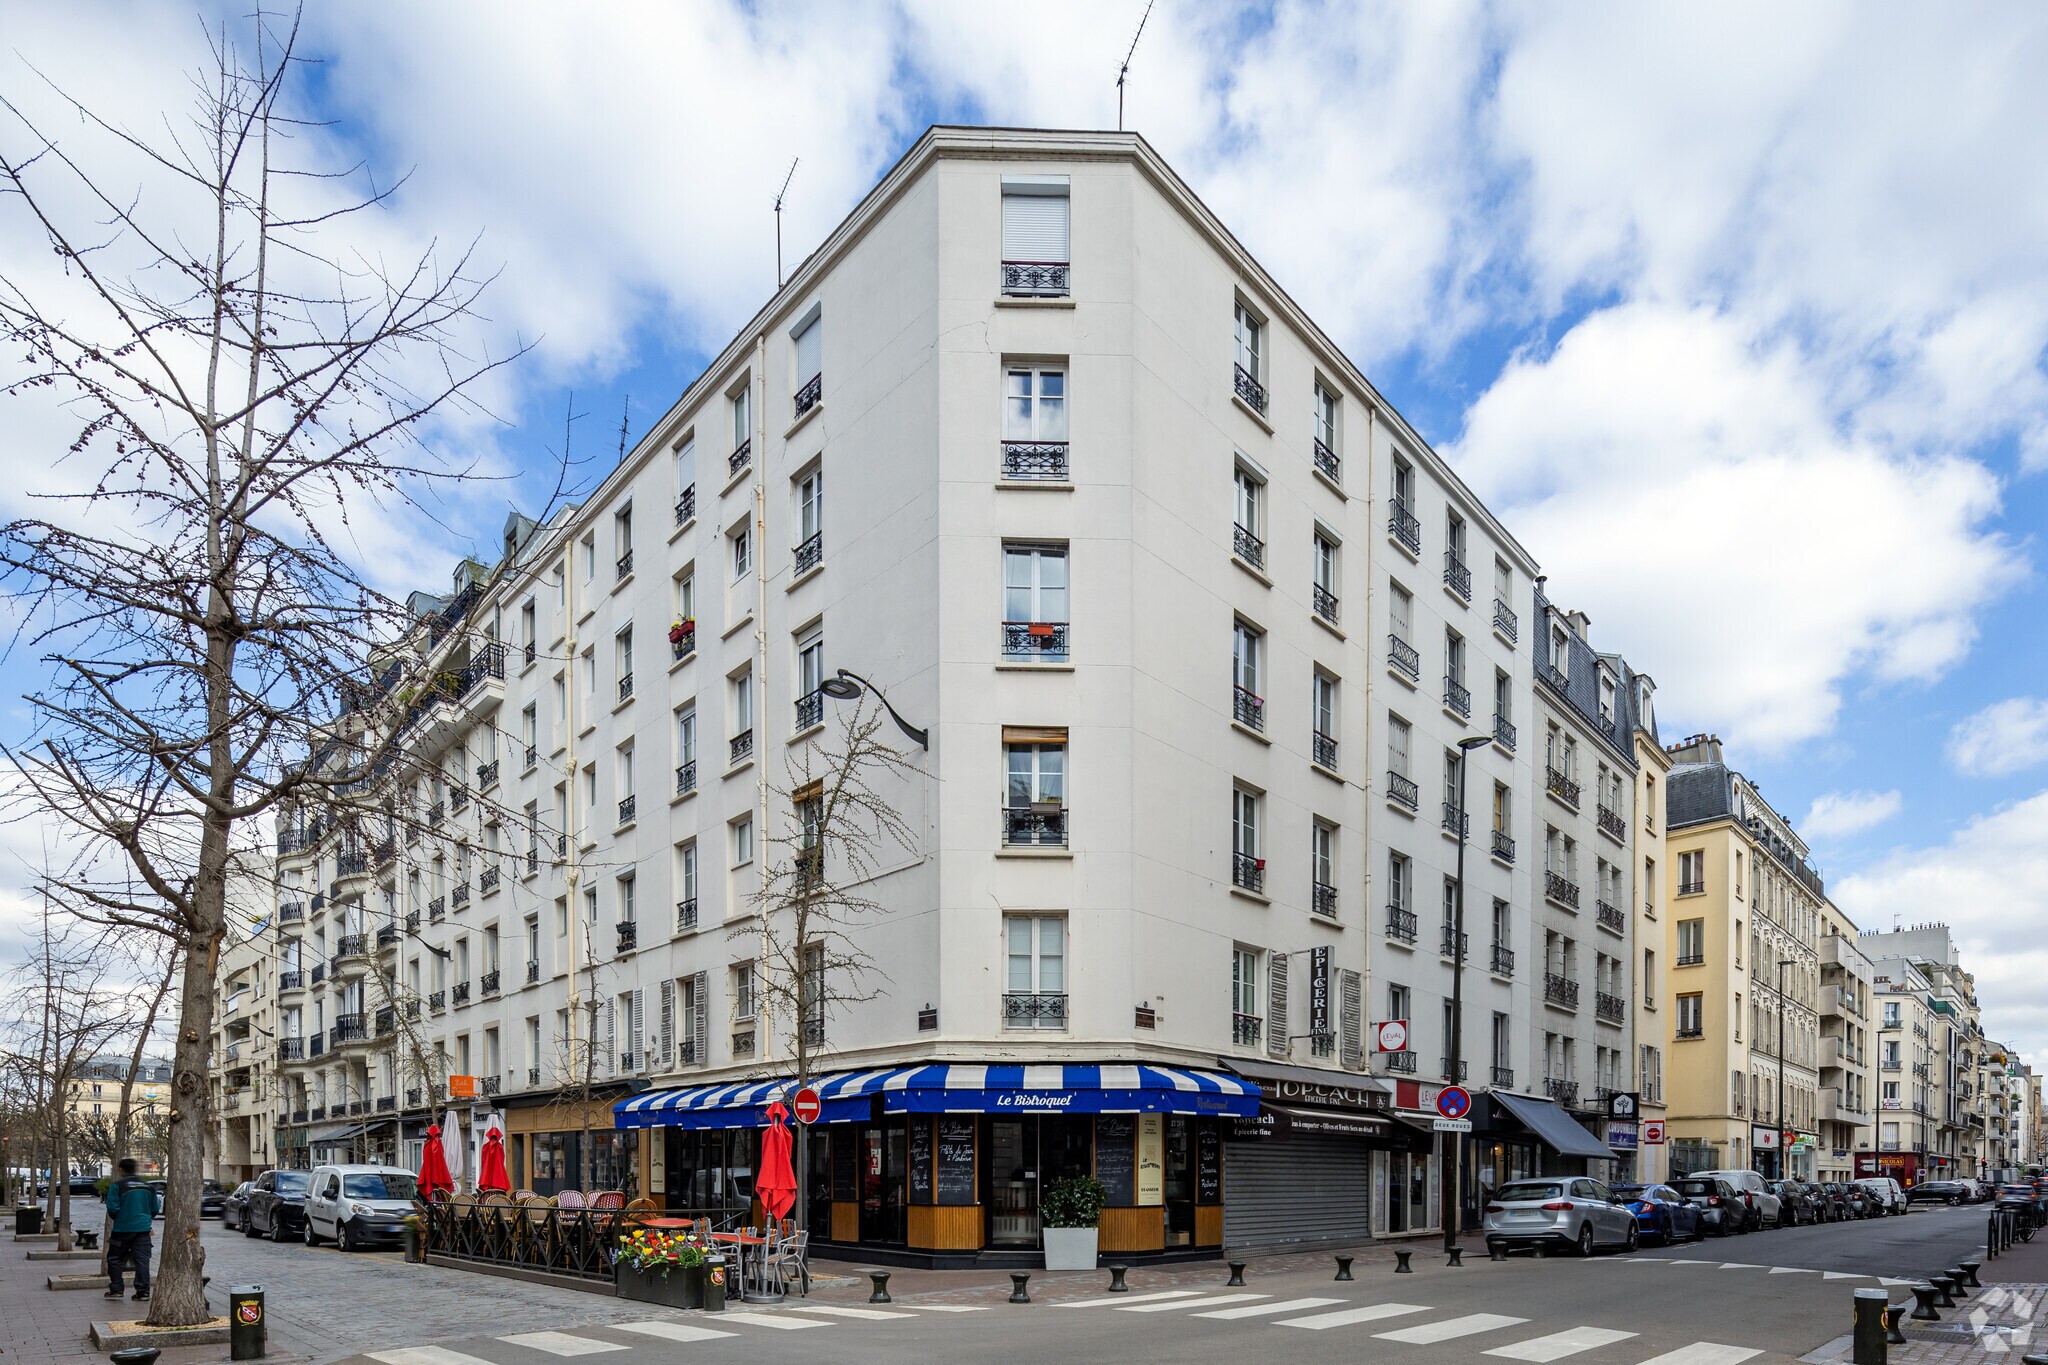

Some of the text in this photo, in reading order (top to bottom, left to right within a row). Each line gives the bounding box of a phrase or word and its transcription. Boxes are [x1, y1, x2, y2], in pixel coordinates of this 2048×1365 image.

[1313, 947, 1326, 1029] EPICERIE
[1311, 1027, 1328, 1036] FINE
[1382, 1032, 1402, 1041] LEVAL
[996, 1094, 1073, 1109] Le Bistroquet
[1329, 1097, 1341, 1106] FINE
[1421, 1090, 1437, 1104] LEVA
[1451, 1122, 1471, 1130] ROUES
[1259, 1128, 1272, 1136] fine
